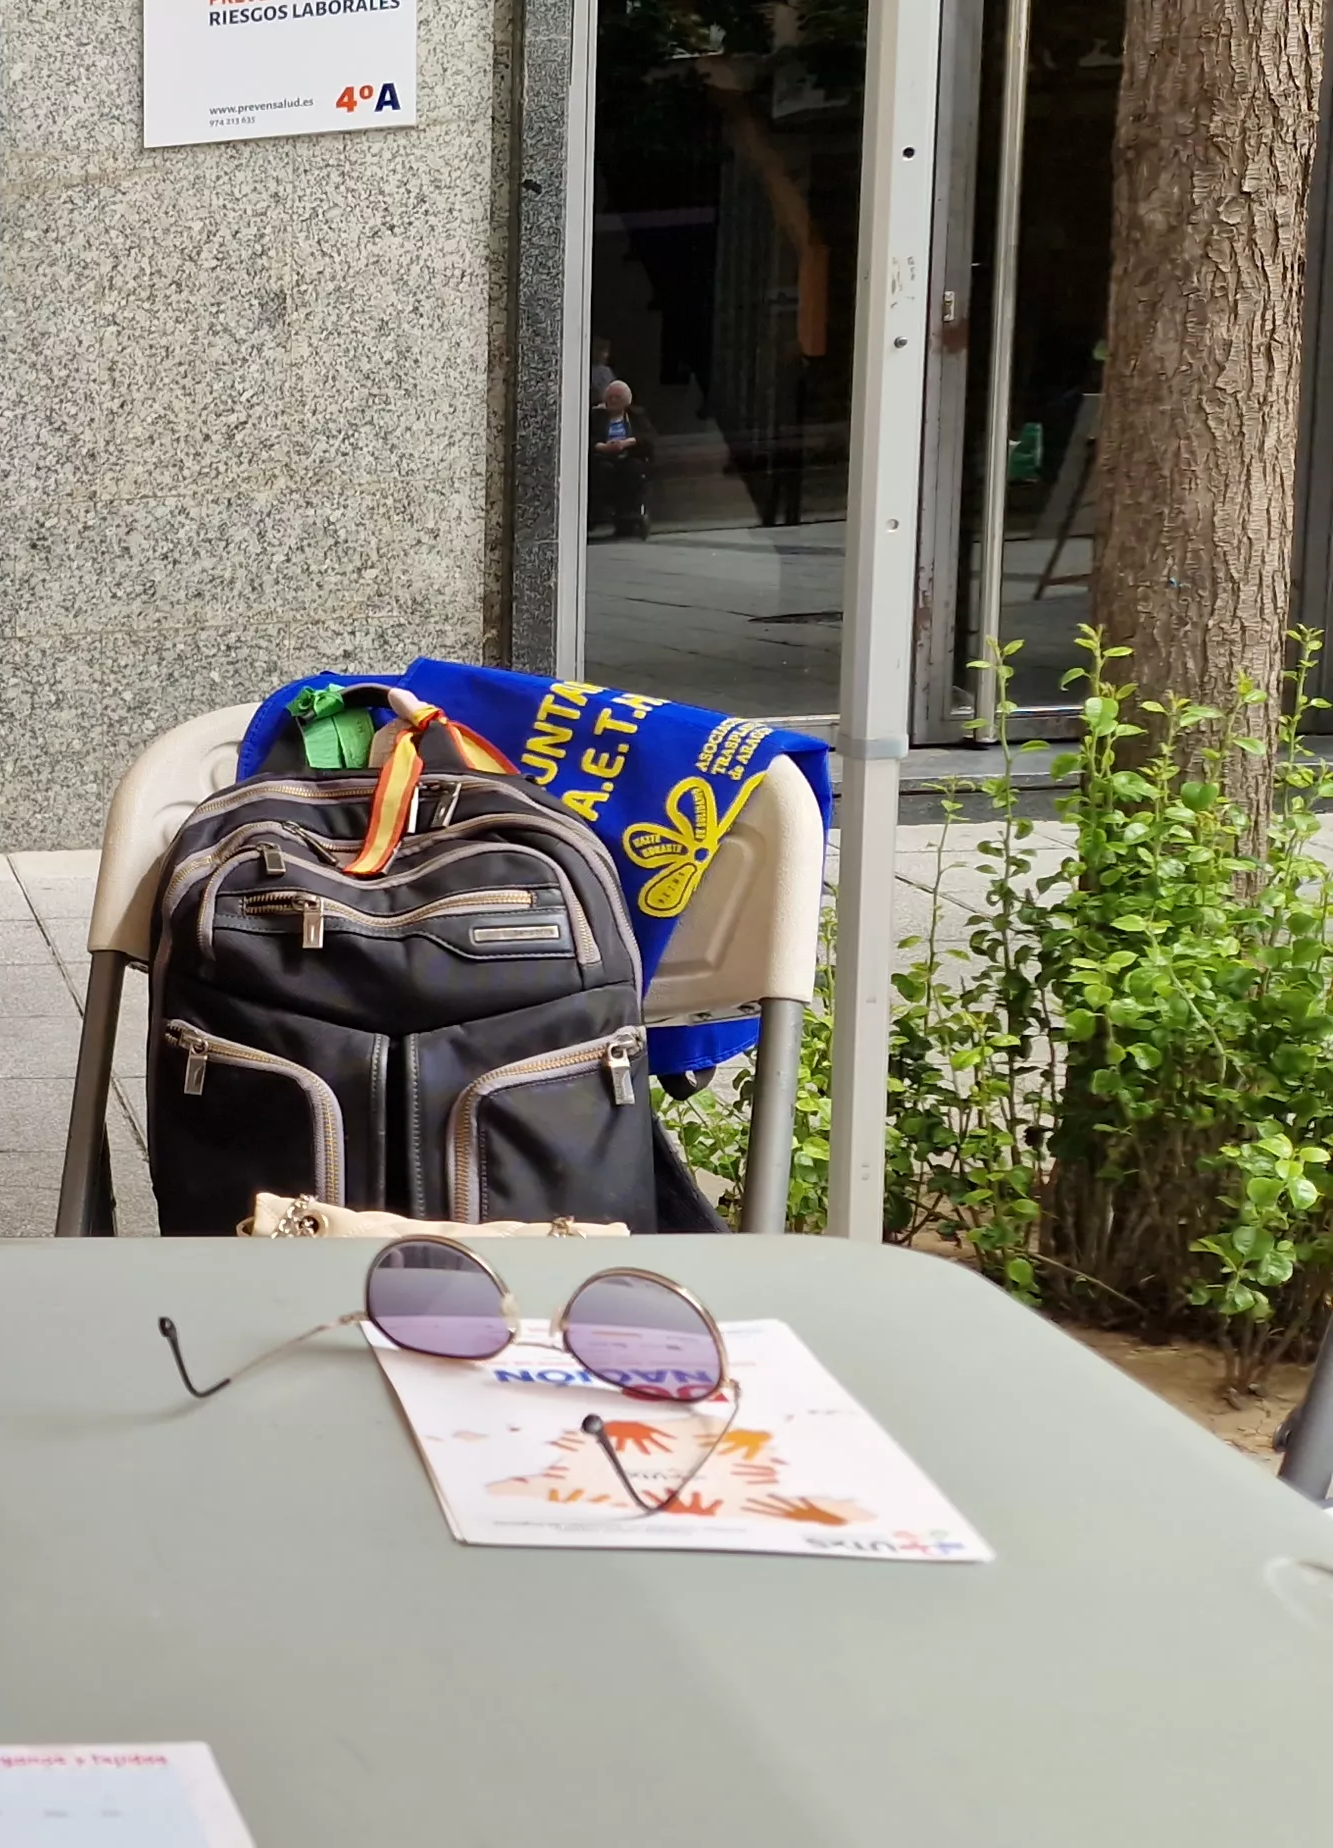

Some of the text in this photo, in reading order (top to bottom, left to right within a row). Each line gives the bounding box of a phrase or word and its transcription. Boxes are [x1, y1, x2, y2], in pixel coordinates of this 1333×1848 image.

[209, 0, 400, 26] RIESGOS LABORALES
[208, 97, 314, 116] www.prevensalud.es
